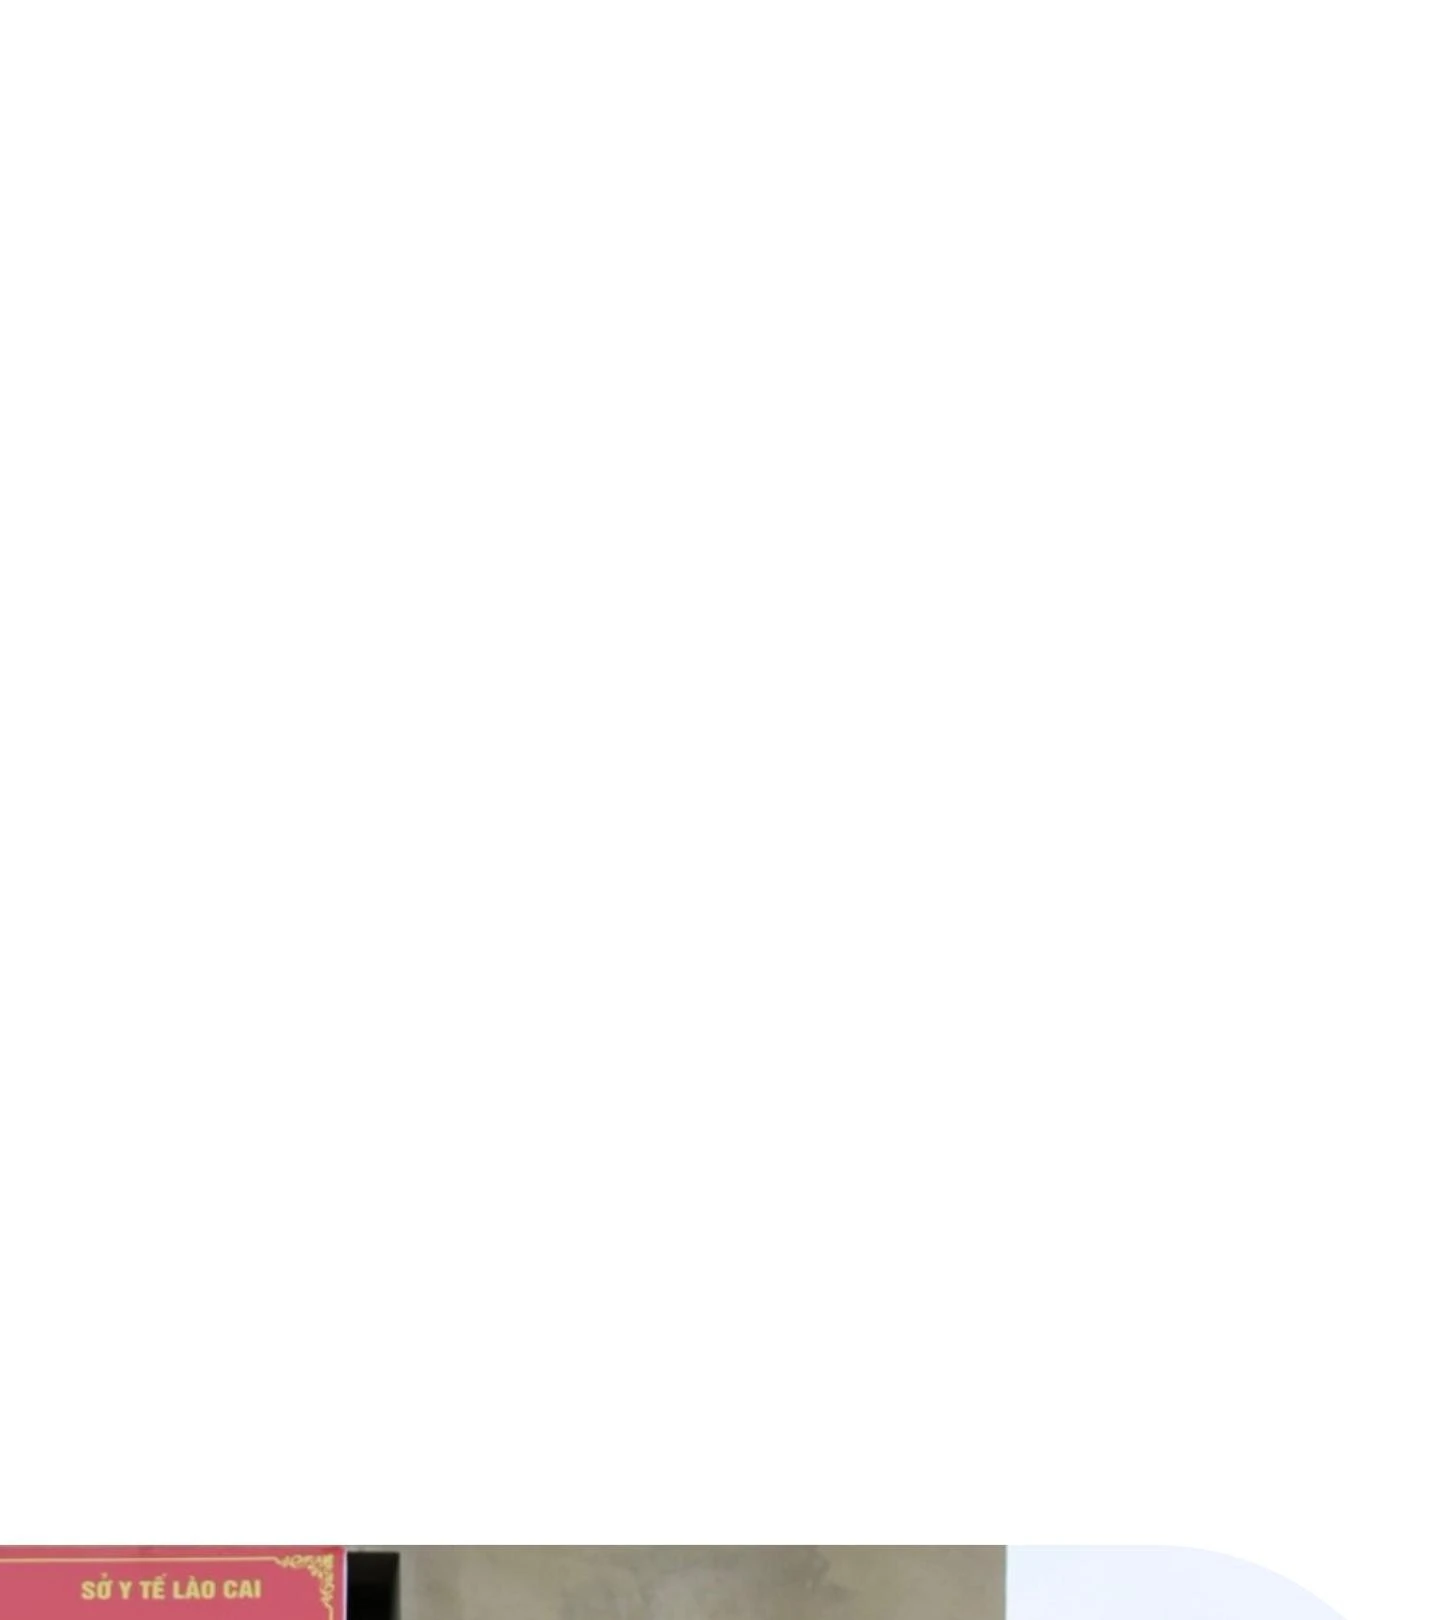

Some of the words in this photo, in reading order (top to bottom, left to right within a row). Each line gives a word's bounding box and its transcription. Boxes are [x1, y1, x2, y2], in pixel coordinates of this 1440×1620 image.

[81, 1572, 113, 1600] SỞ
[119, 1580, 133, 1600] Y
[138, 1572, 167, 1600] TẾ
[172, 1575, 216, 1600] LÀO
[223, 1579, 262, 1599] CAI
